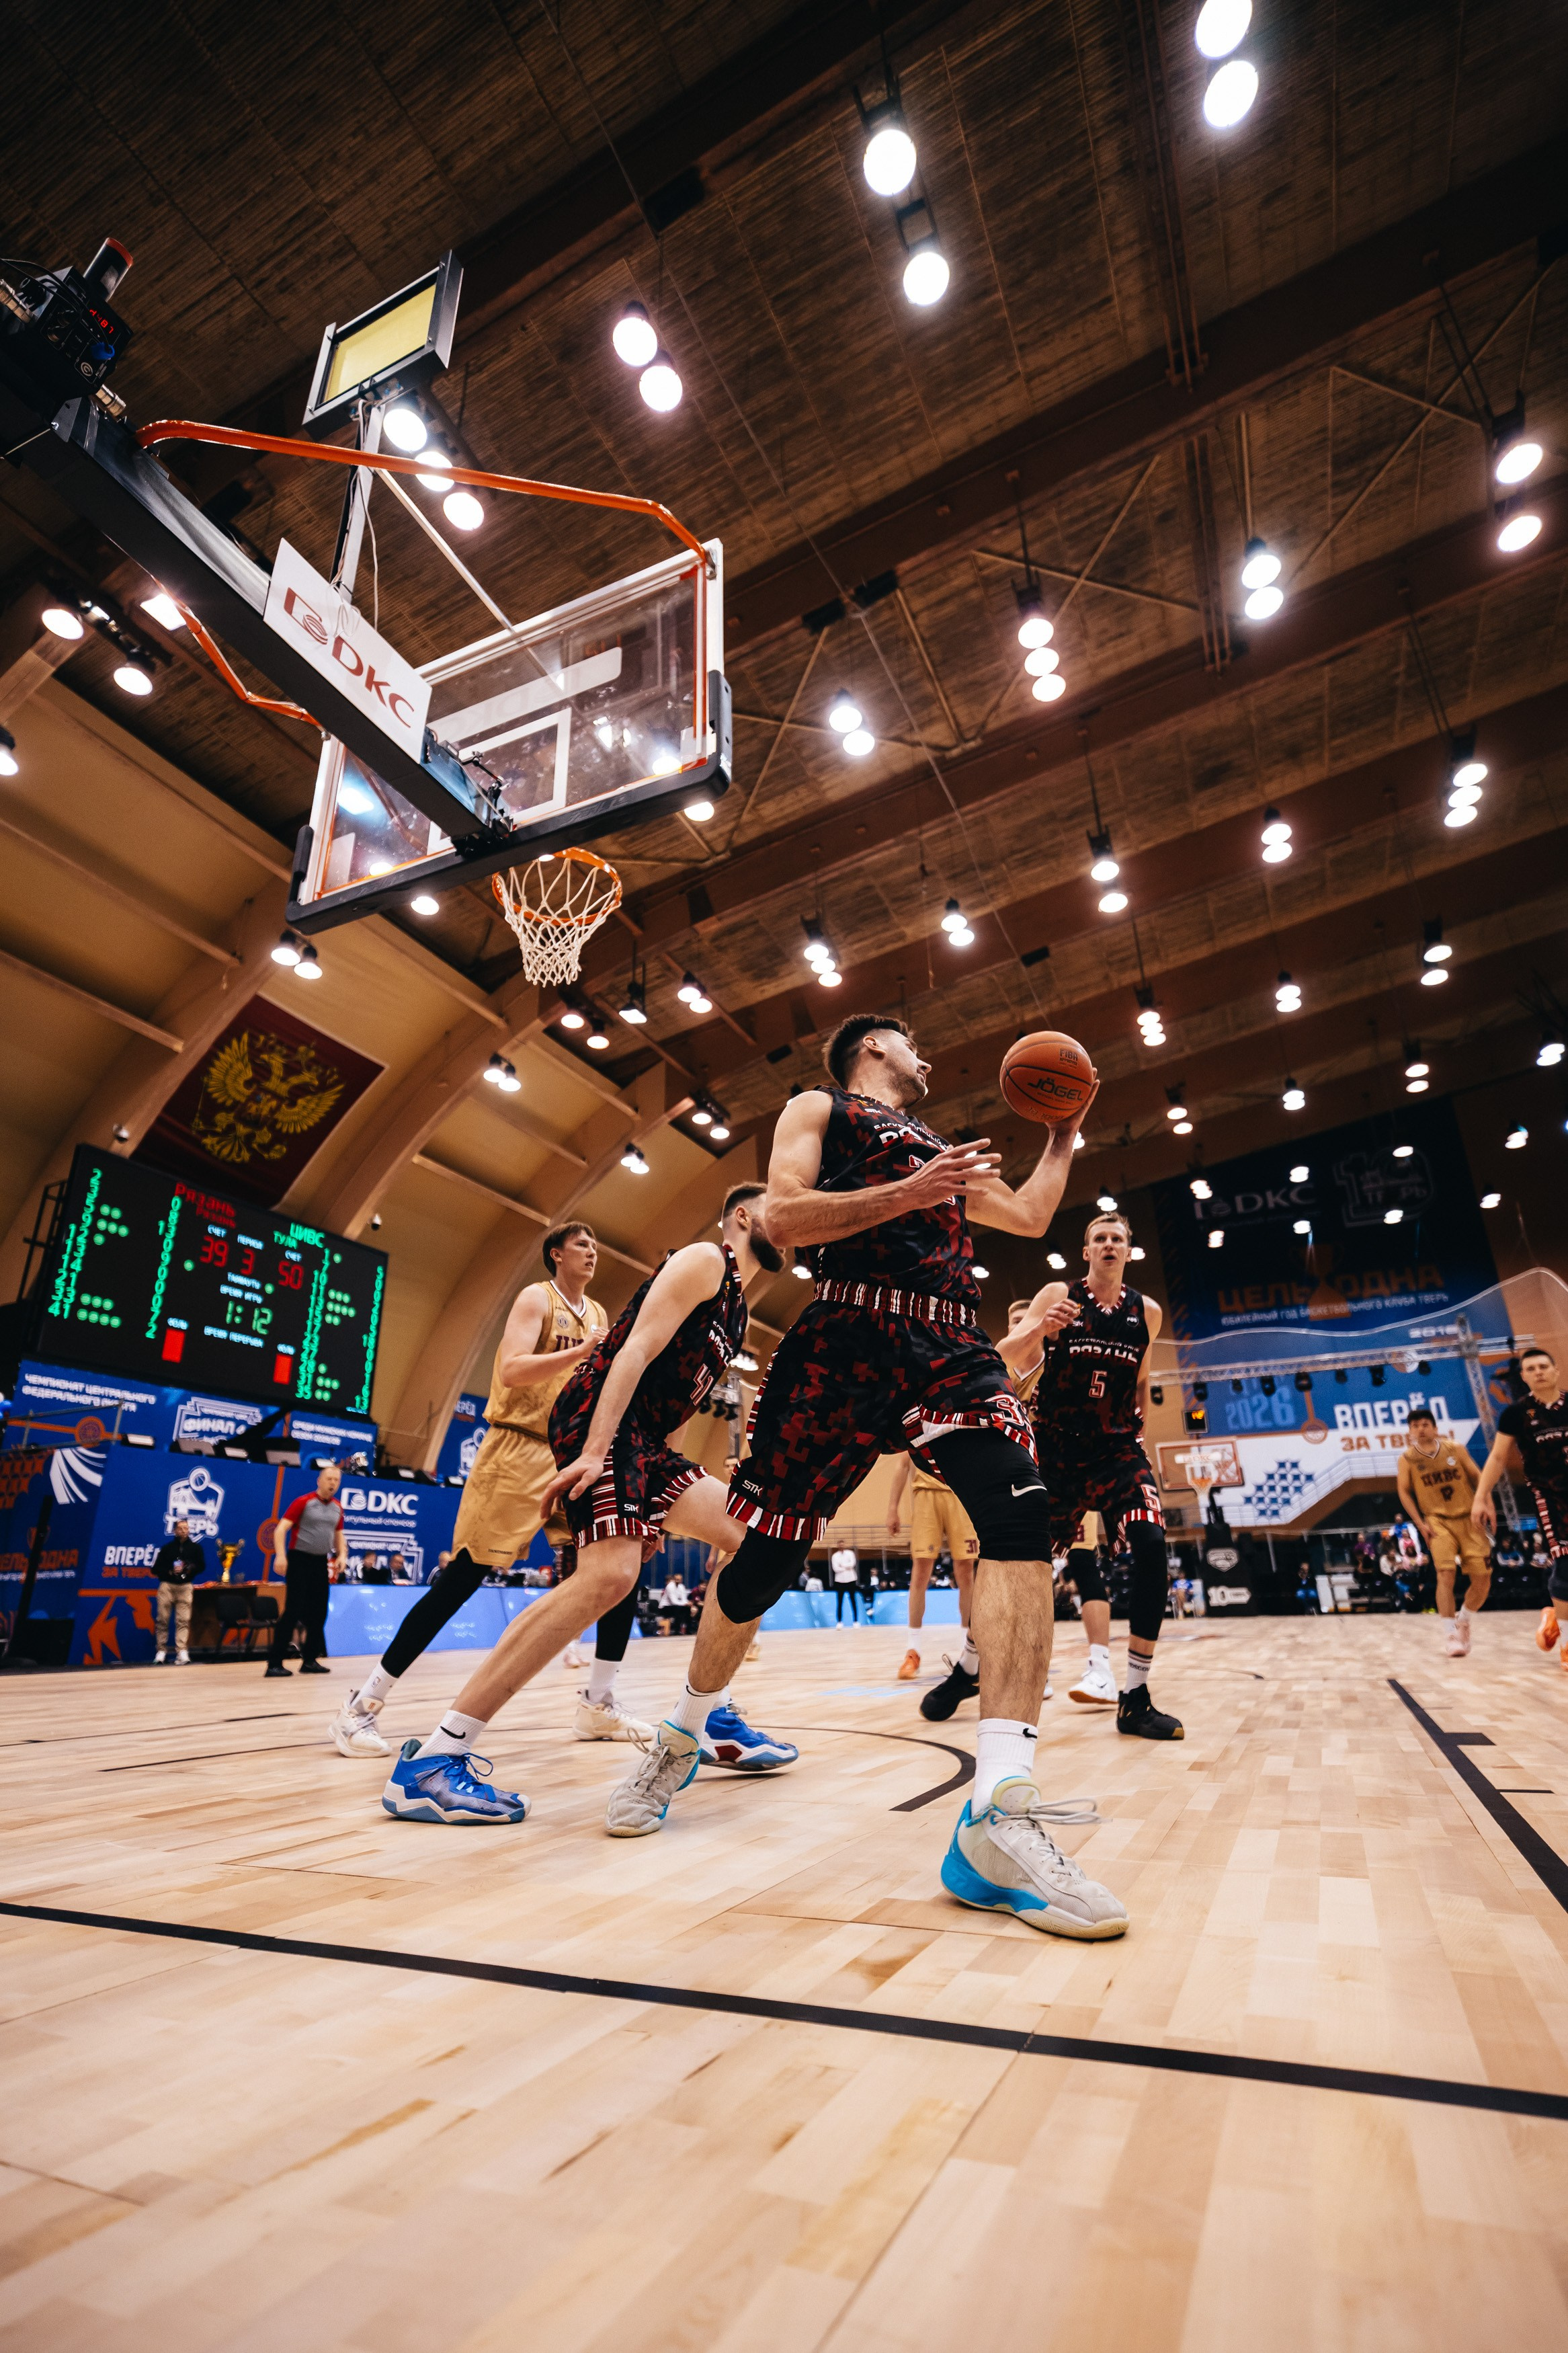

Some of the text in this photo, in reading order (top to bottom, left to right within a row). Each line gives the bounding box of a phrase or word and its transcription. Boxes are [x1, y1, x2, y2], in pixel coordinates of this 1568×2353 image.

[331, 636, 415, 729] DKC
[1059, 1049, 1078, 1062] FIBA
[1027, 1077, 1083, 1102] JÖGEL
[1235, 1185, 1315, 1214] DKC
[273, 1230, 298, 1250] ТУЛА
[290, 1222, 326, 1248] ЦИВС
[200, 1235, 230, 1268] 39
[240, 1248, 256, 1276] 3
[278, 1261, 304, 1290] 50
[225, 1300, 274, 1335] 1:12
[1088, 1370, 1108, 1399] 5
[1227, 1386, 1295, 1431] 2026
[1340, 1436, 1370, 1452] ЗА
[741, 1479, 763, 1497] STK
[1141, 1484, 1161, 1512] 5
[366, 1490, 419, 1515] DKC
[624, 1503, 639, 1514] STK
[164, 1513, 218, 1538] ТЕРЬ
